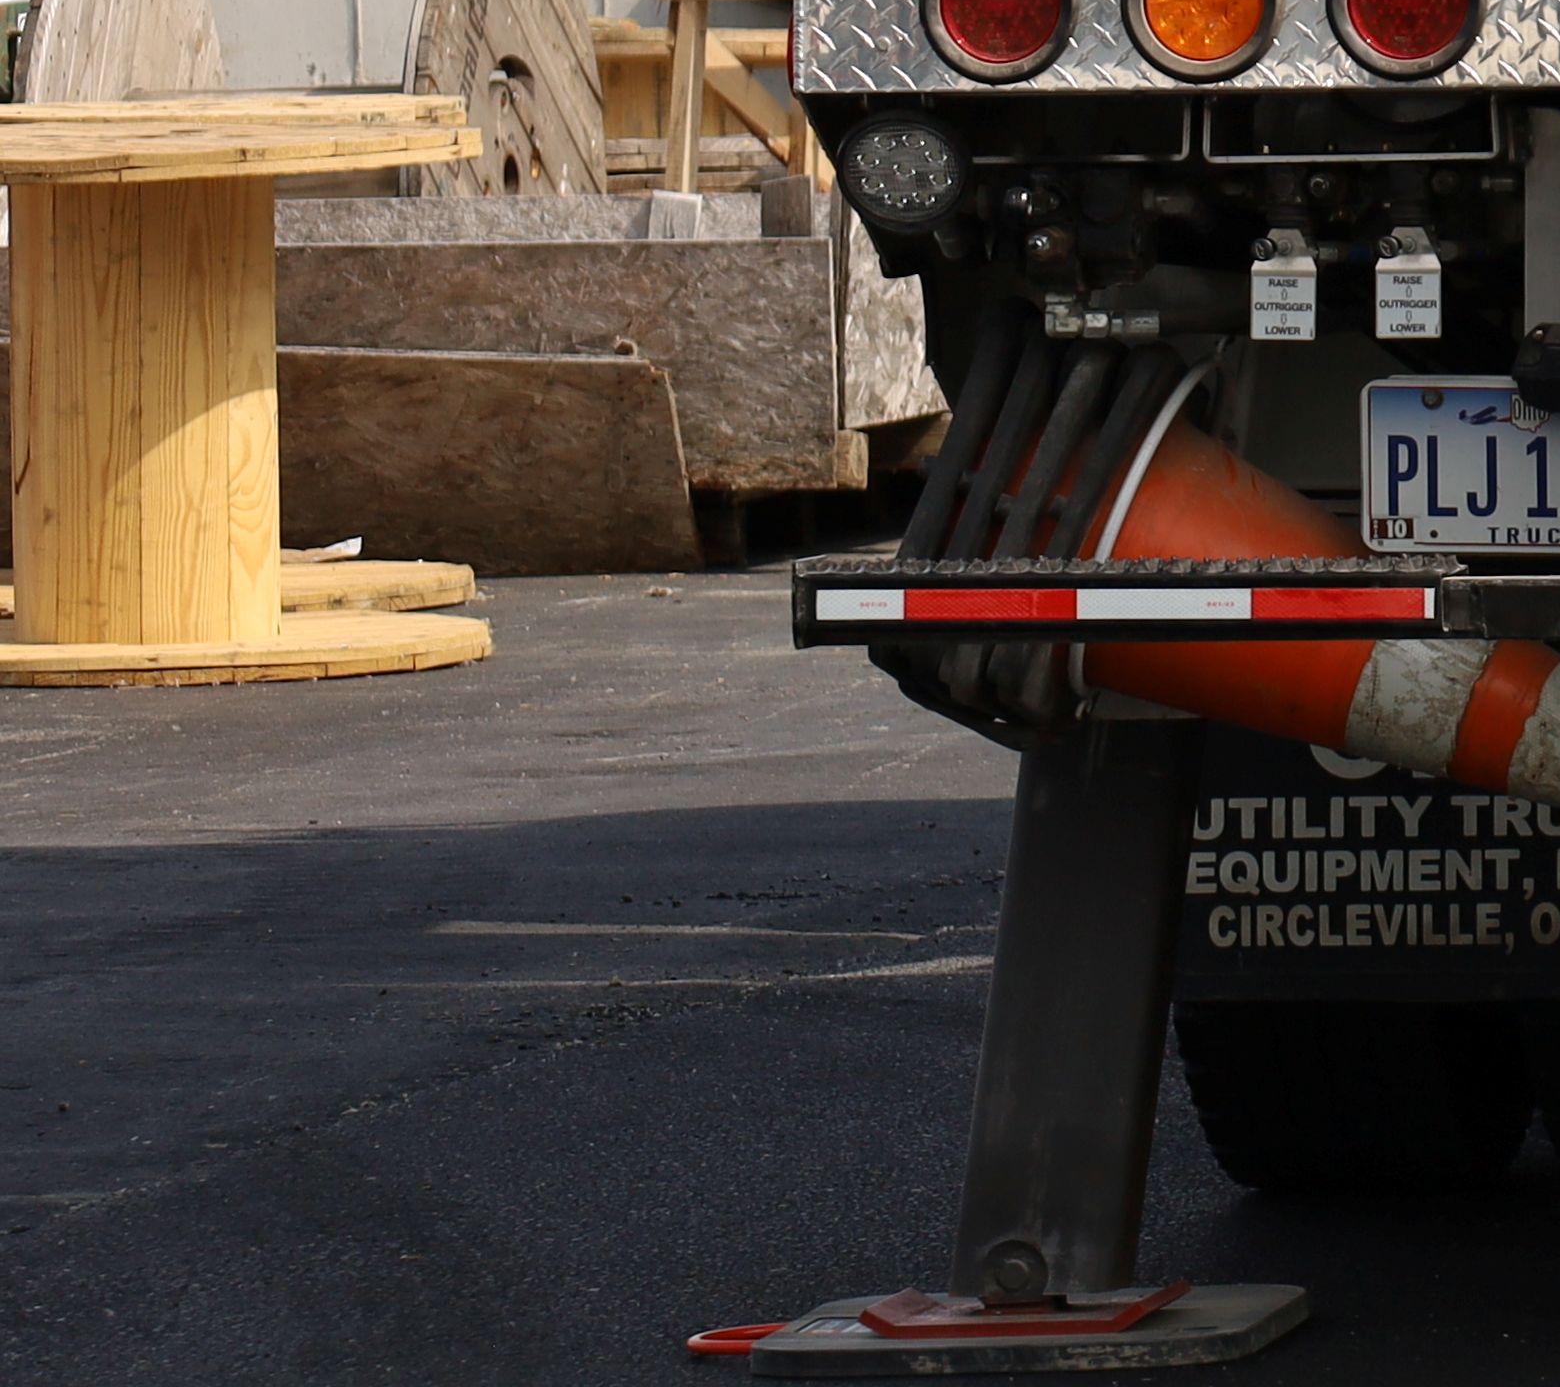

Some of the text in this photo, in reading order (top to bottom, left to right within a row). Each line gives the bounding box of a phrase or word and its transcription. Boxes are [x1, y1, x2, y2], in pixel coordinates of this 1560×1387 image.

[1268, 278, 1298, 288] RAISE
[1393, 276, 1423, 285] RAISE
[1254, 301, 1313, 311] OUTRIGGER
[1379, 299, 1437, 309] OUTRIGGER
[1265, 326, 1301, 335] LOWER
[1389, 323, 1426, 332] LOWER
[1387, 434, 1498, 517] PLJ
[1385, 521, 1407, 539] 10
[1193, 795, 1432, 840] UTILITY
[1185, 848, 1535, 900] EQUIPMENT,
[1208, 902, 1515, 954] CIRCLEVILLE,
